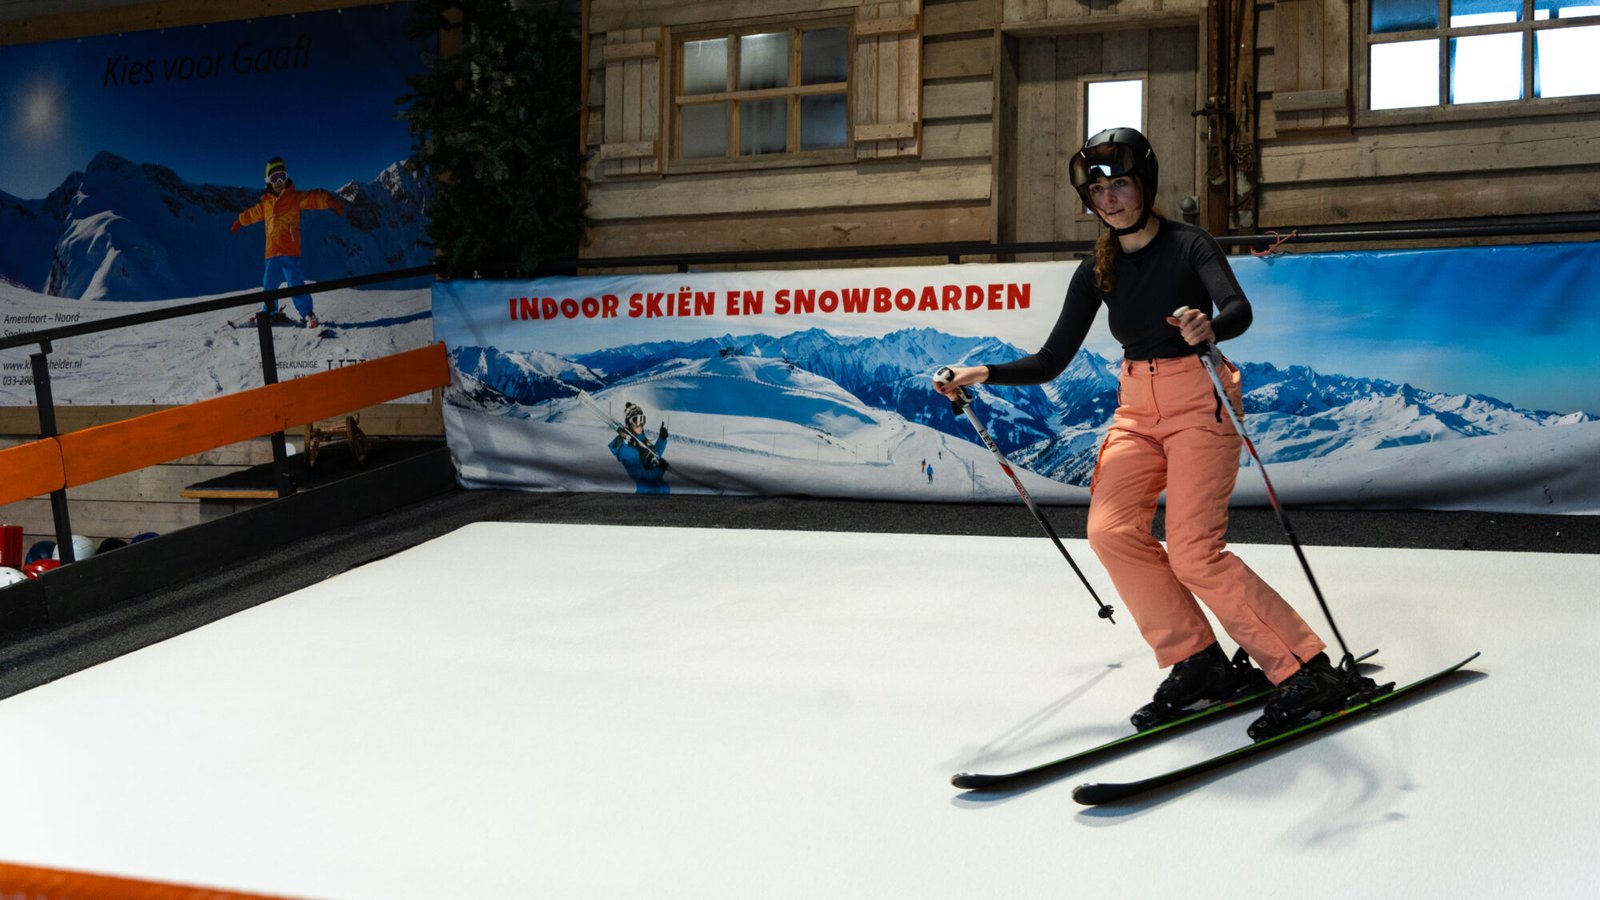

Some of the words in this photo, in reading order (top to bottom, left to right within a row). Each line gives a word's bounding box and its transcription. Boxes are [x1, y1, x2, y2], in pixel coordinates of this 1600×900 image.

[103, 55, 155, 88] Kies
[162, 51, 227, 81] voor
[232, 32, 312, 75] Gaaf!
[4, 313, 47, 324] Amersfoort
[54, 312, 80, 323] Noord
[509, 294, 619, 321] INDOOR
[628, 286, 715, 318] SKIËN
[726, 290, 764, 316] EN
[774, 283, 1031, 315] SNOWBOARDEN
